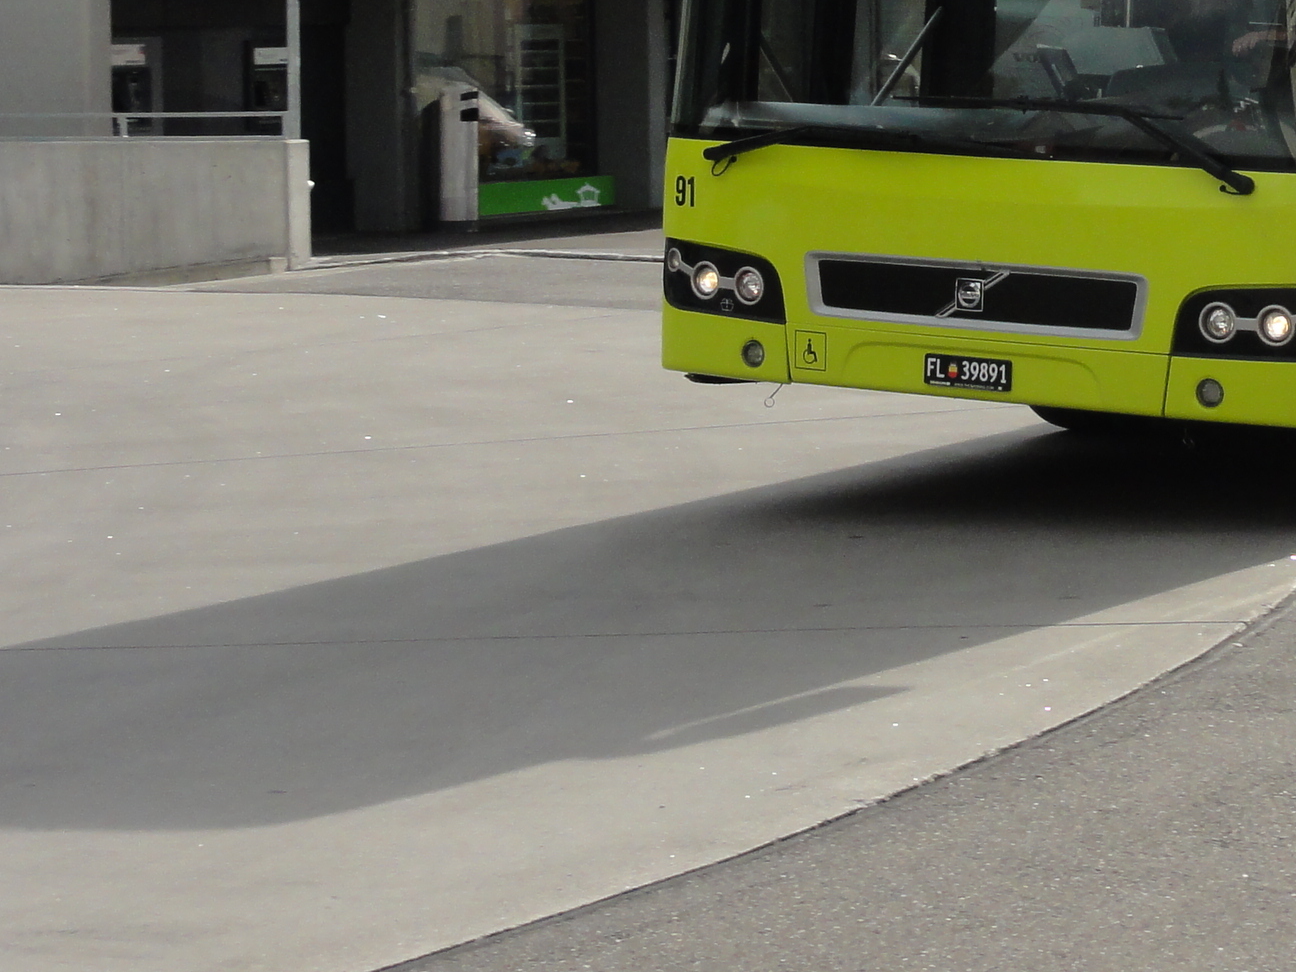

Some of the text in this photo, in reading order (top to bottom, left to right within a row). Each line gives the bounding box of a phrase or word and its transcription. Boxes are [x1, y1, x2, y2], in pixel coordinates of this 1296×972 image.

[675, 175, 695, 207] 91
[926, 357, 1007, 384] FL 39891
